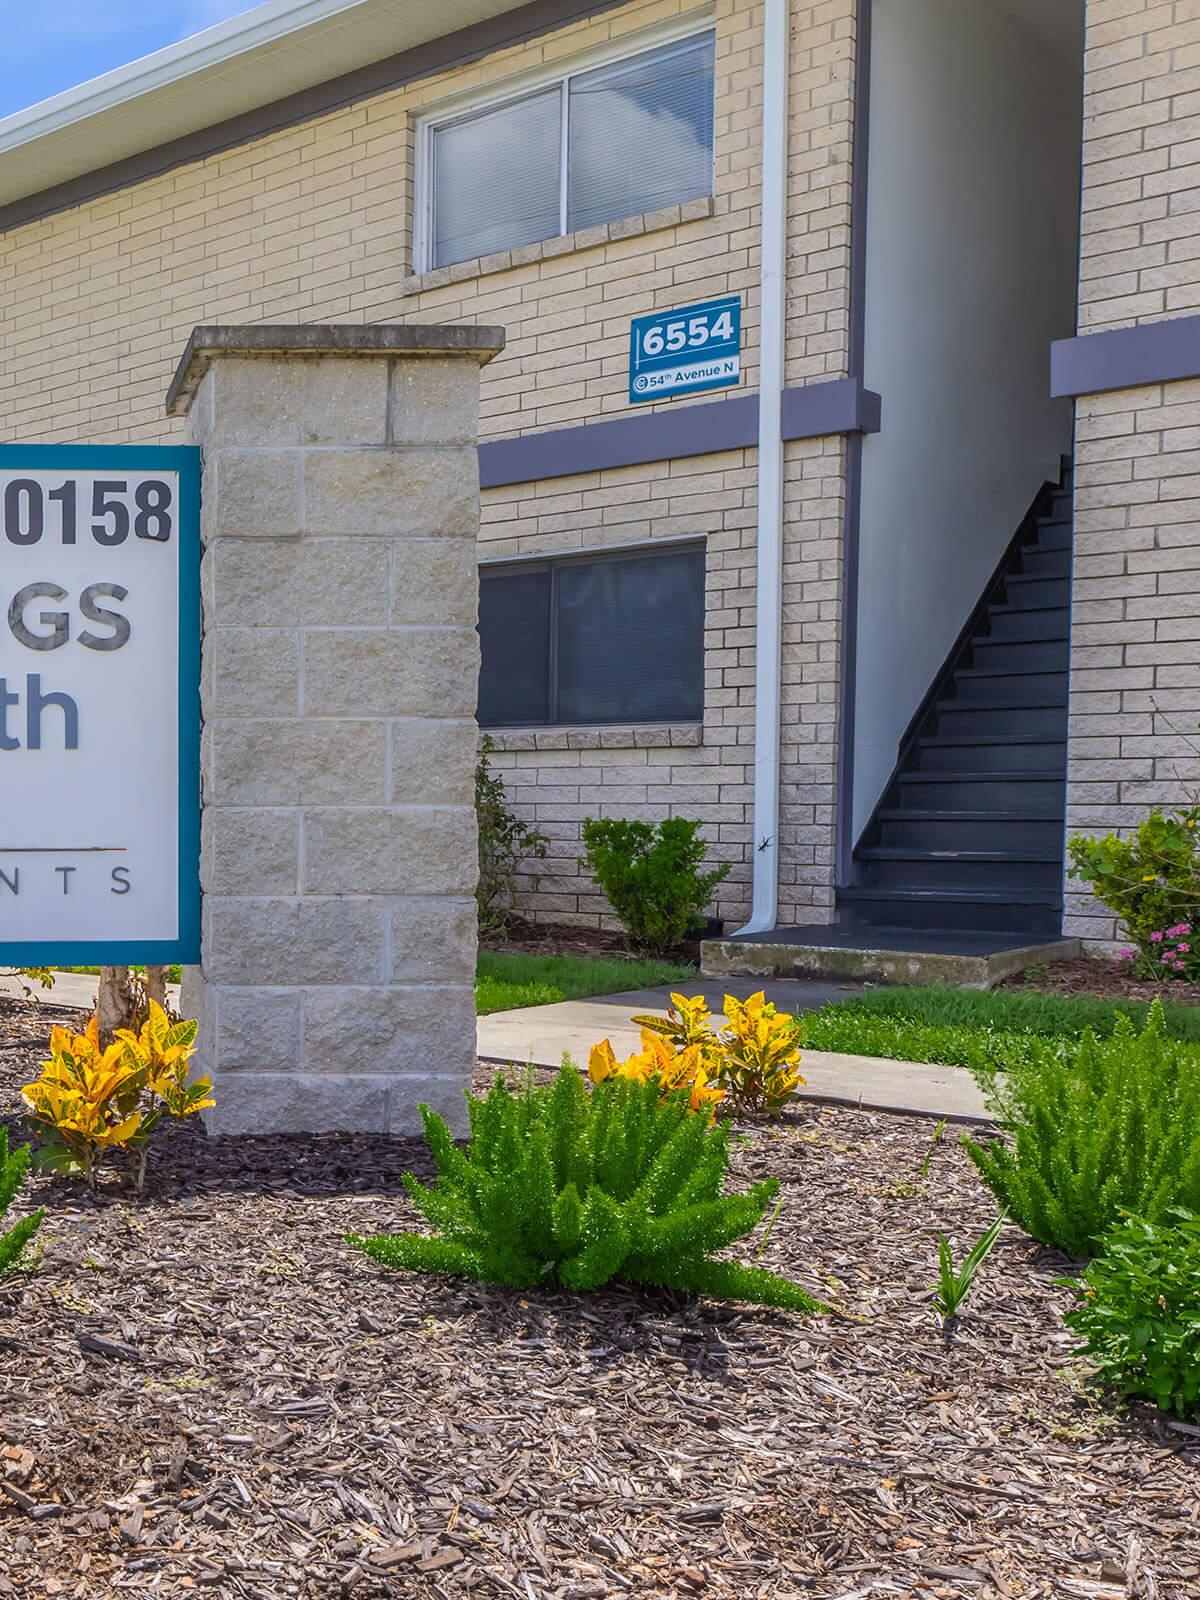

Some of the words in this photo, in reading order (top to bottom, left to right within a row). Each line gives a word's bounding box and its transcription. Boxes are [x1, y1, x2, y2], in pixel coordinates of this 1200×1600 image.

[643, 311, 734, 355] 6554
[674, 366, 720, 383] Avenue
[723, 361, 734, 374] N
[4, 479, 174, 546] 0158
